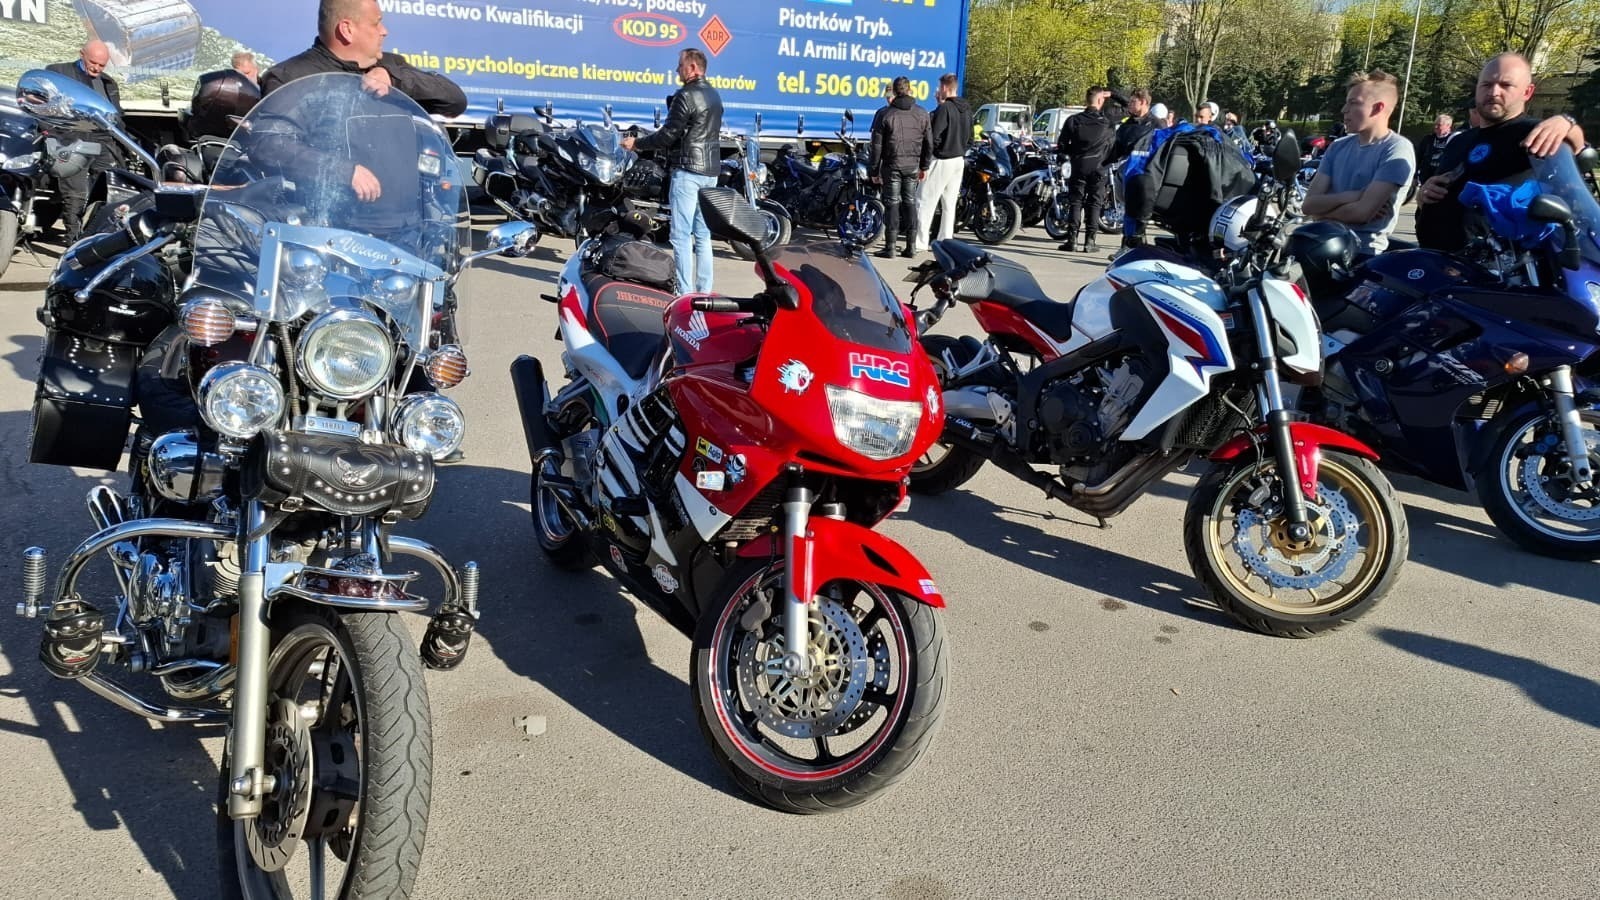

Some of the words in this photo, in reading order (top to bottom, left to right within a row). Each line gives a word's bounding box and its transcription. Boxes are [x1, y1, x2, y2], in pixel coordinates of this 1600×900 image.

[378, 0, 481, 21] wiadectwo
[486, 5, 584, 35] Kwalifikacji
[646, 0, 706, 18] podesty
[778, 7, 852, 33] Piotrków
[855, 15, 893, 40] Tryb.
[621, 19, 657, 38] KOD
[659, 23, 679, 40] 95
[706, 30, 724, 42] ADR
[392, 48, 440, 69] ania
[444, 55, 578, 80] psychologiczne
[582, 63, 665, 85] kierowców
[668, 70, 672, 85] i
[777, 37, 800, 57] Al.
[803, 39, 847, 61] Armii
[850, 43, 916, 70] Krajowej
[918, 50, 946, 69] 22A
[777, 70, 810, 95] tel.
[815, 73, 852, 97] 506
[855, 75, 892, 98] 087
[908, 79, 930, 101] 50
[674, 325, 701, 351] HONDA
[848, 352, 911, 388] HRC
